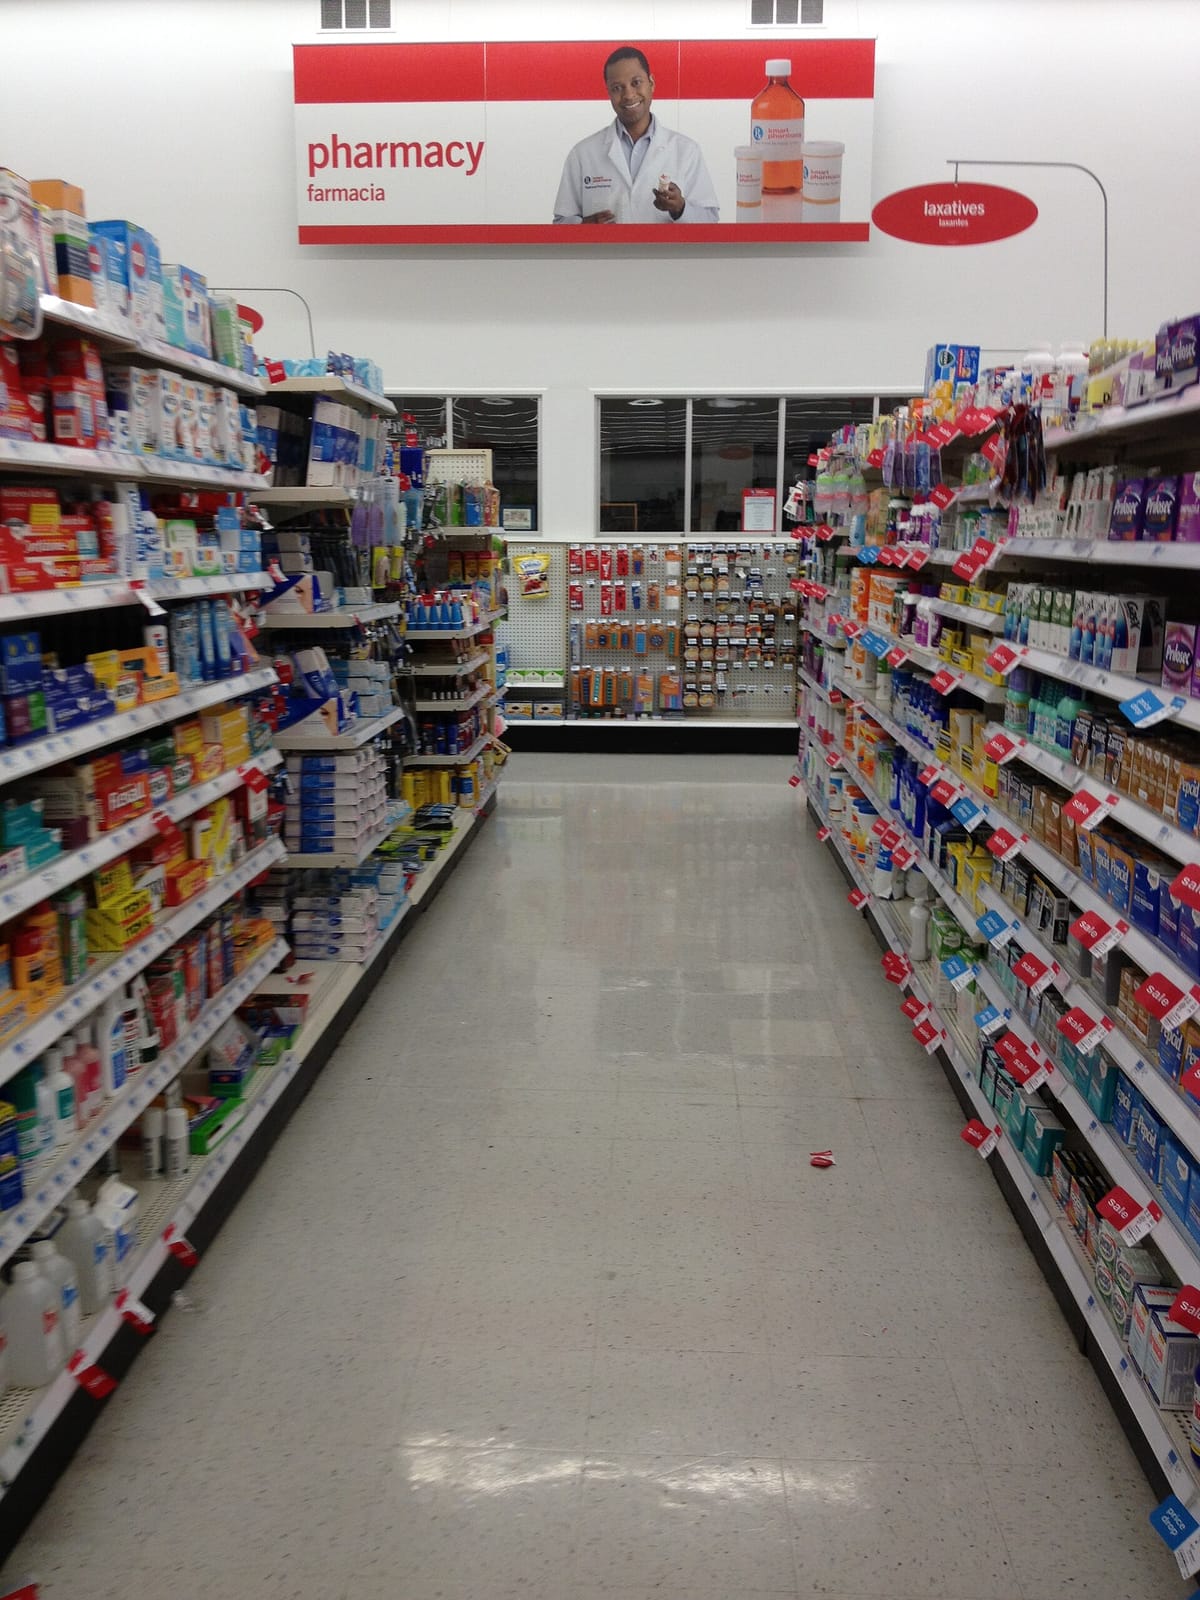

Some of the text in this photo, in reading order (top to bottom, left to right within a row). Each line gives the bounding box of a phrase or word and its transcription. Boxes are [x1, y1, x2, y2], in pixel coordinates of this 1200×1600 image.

[308, 133, 485, 177] pharmacy
[307, 183, 386, 202] farmacia
[924, 200, 985, 216] laxatives
[938, 218, 969, 228] laxantes
[1113, 494, 1139, 516] Prilosec
[1146, 494, 1173, 516] Prilosec
[1166, 643, 1191, 666] Prilosec
[1072, 799, 1090, 815] sale
[1181, 876, 1200, 895] sal
[1079, 920, 1099, 938] sale
[1021, 961, 1038, 977] sale
[1146, 985, 1170, 1007] sale
[1066, 1016, 1085, 1034] sale
[1013, 1058, 1030, 1076] sale
[1108, 1198, 1129, 1219] sale
[1161, 1516, 1178, 1536] drop
[1166, 1507, 1186, 1531] price
